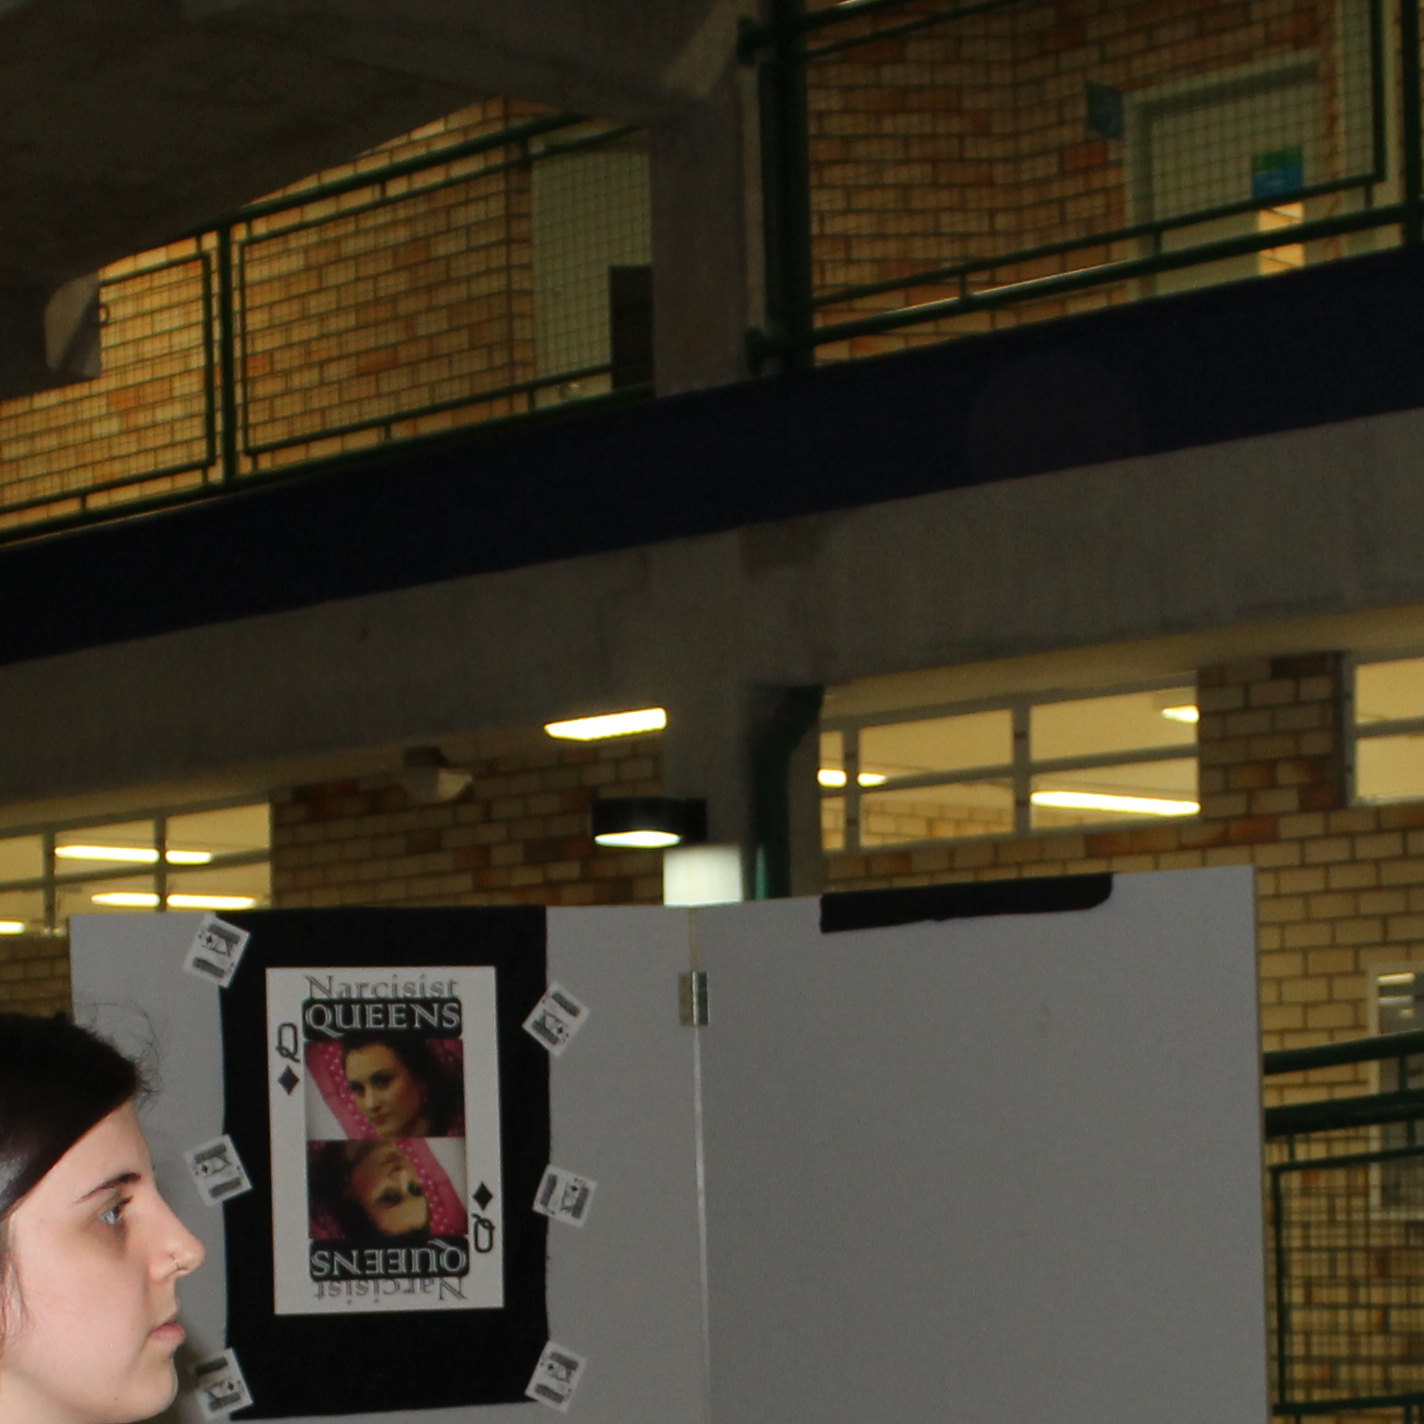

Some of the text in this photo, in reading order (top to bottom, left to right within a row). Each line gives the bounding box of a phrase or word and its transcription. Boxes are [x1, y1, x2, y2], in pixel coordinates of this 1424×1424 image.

[305, 974, 459, 999] Narcisist
[305, 1002, 461, 1038] QUEENS
[276, 1022, 300, 1063] Q
[471, 1213, 495, 1253] Q
[311, 1238, 467, 1277] QUEENS
[314, 1277, 467, 1305] Narcisist
